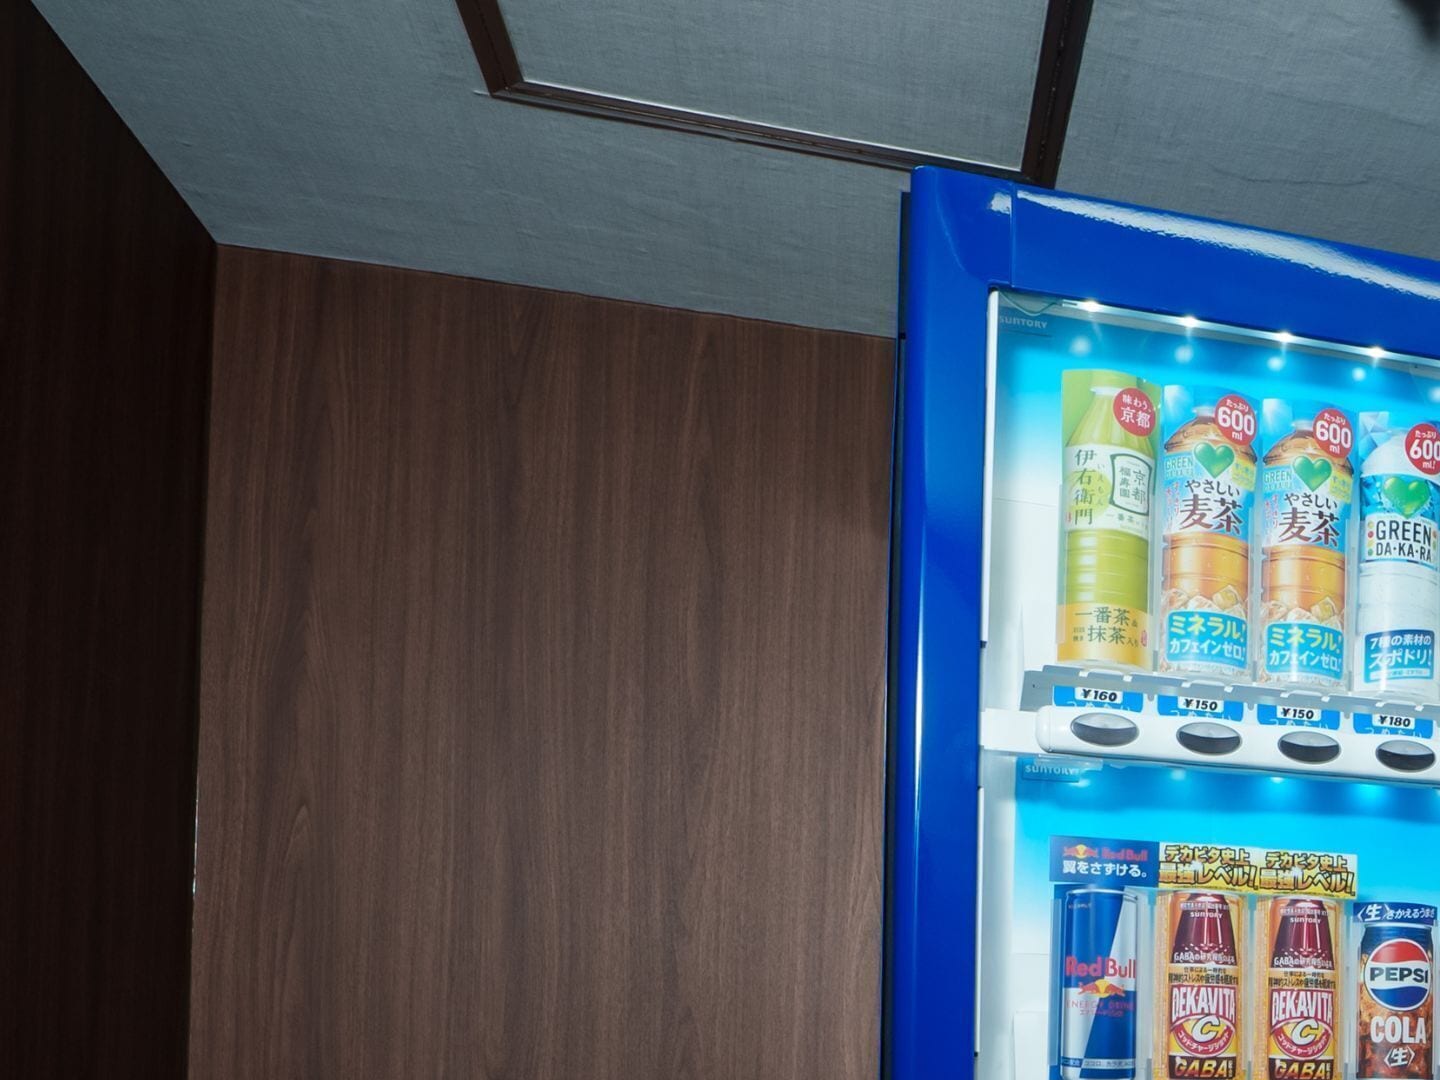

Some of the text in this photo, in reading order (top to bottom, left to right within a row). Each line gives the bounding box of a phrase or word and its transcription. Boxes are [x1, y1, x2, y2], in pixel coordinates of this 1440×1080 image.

[1225, 397, 1249, 412] たっぷり
[1119, 407, 1151, 429] 京都
[1217, 405, 1255, 435] 600
[1323, 411, 1346, 426] たっぷり
[1232, 429, 1243, 441] ml
[1315, 419, 1352, 448] 600
[1329, 443, 1341, 454] ml
[1074, 449, 1097, 526] 伊右衛門
[1185, 479, 1240, 497] やさしい
[1283, 492, 1338, 511] やさしい
[1179, 495, 1243, 535] 麦茶
[1278, 508, 1340, 547] 麦茶
[1376, 519, 1432, 546] GREEN
[1169, 614, 1247, 641] ミネラル!
[1269, 626, 1343, 653] ミネラル!
[1081, 688, 1119, 703] ¥160
[1183, 698, 1219, 712] ¥150
[1281, 706, 1316, 721] ¥150
[1377, 715, 1412, 729] ¥180
[1165, 845, 1251, 866] デカビタ史上
[1265, 851, 1349, 873] デカビタ史上
[1063, 860, 1147, 878] 翼をさずける。
[1066, 956, 1136, 978] Red Bull
[1369, 966, 1429, 984] PEPSI
[1172, 985, 1237, 1024] DEKAVITA
[1271, 989, 1334, 1028] DEKAVITA
[1192, 1014, 1221, 1042] C
[1291, 1018, 1319, 1046] C
[1370, 1015, 1428, 1045] COLA
[1175, 1057, 1229, 1080] GABA
[1275, 1059, 1327, 1080] GABA
